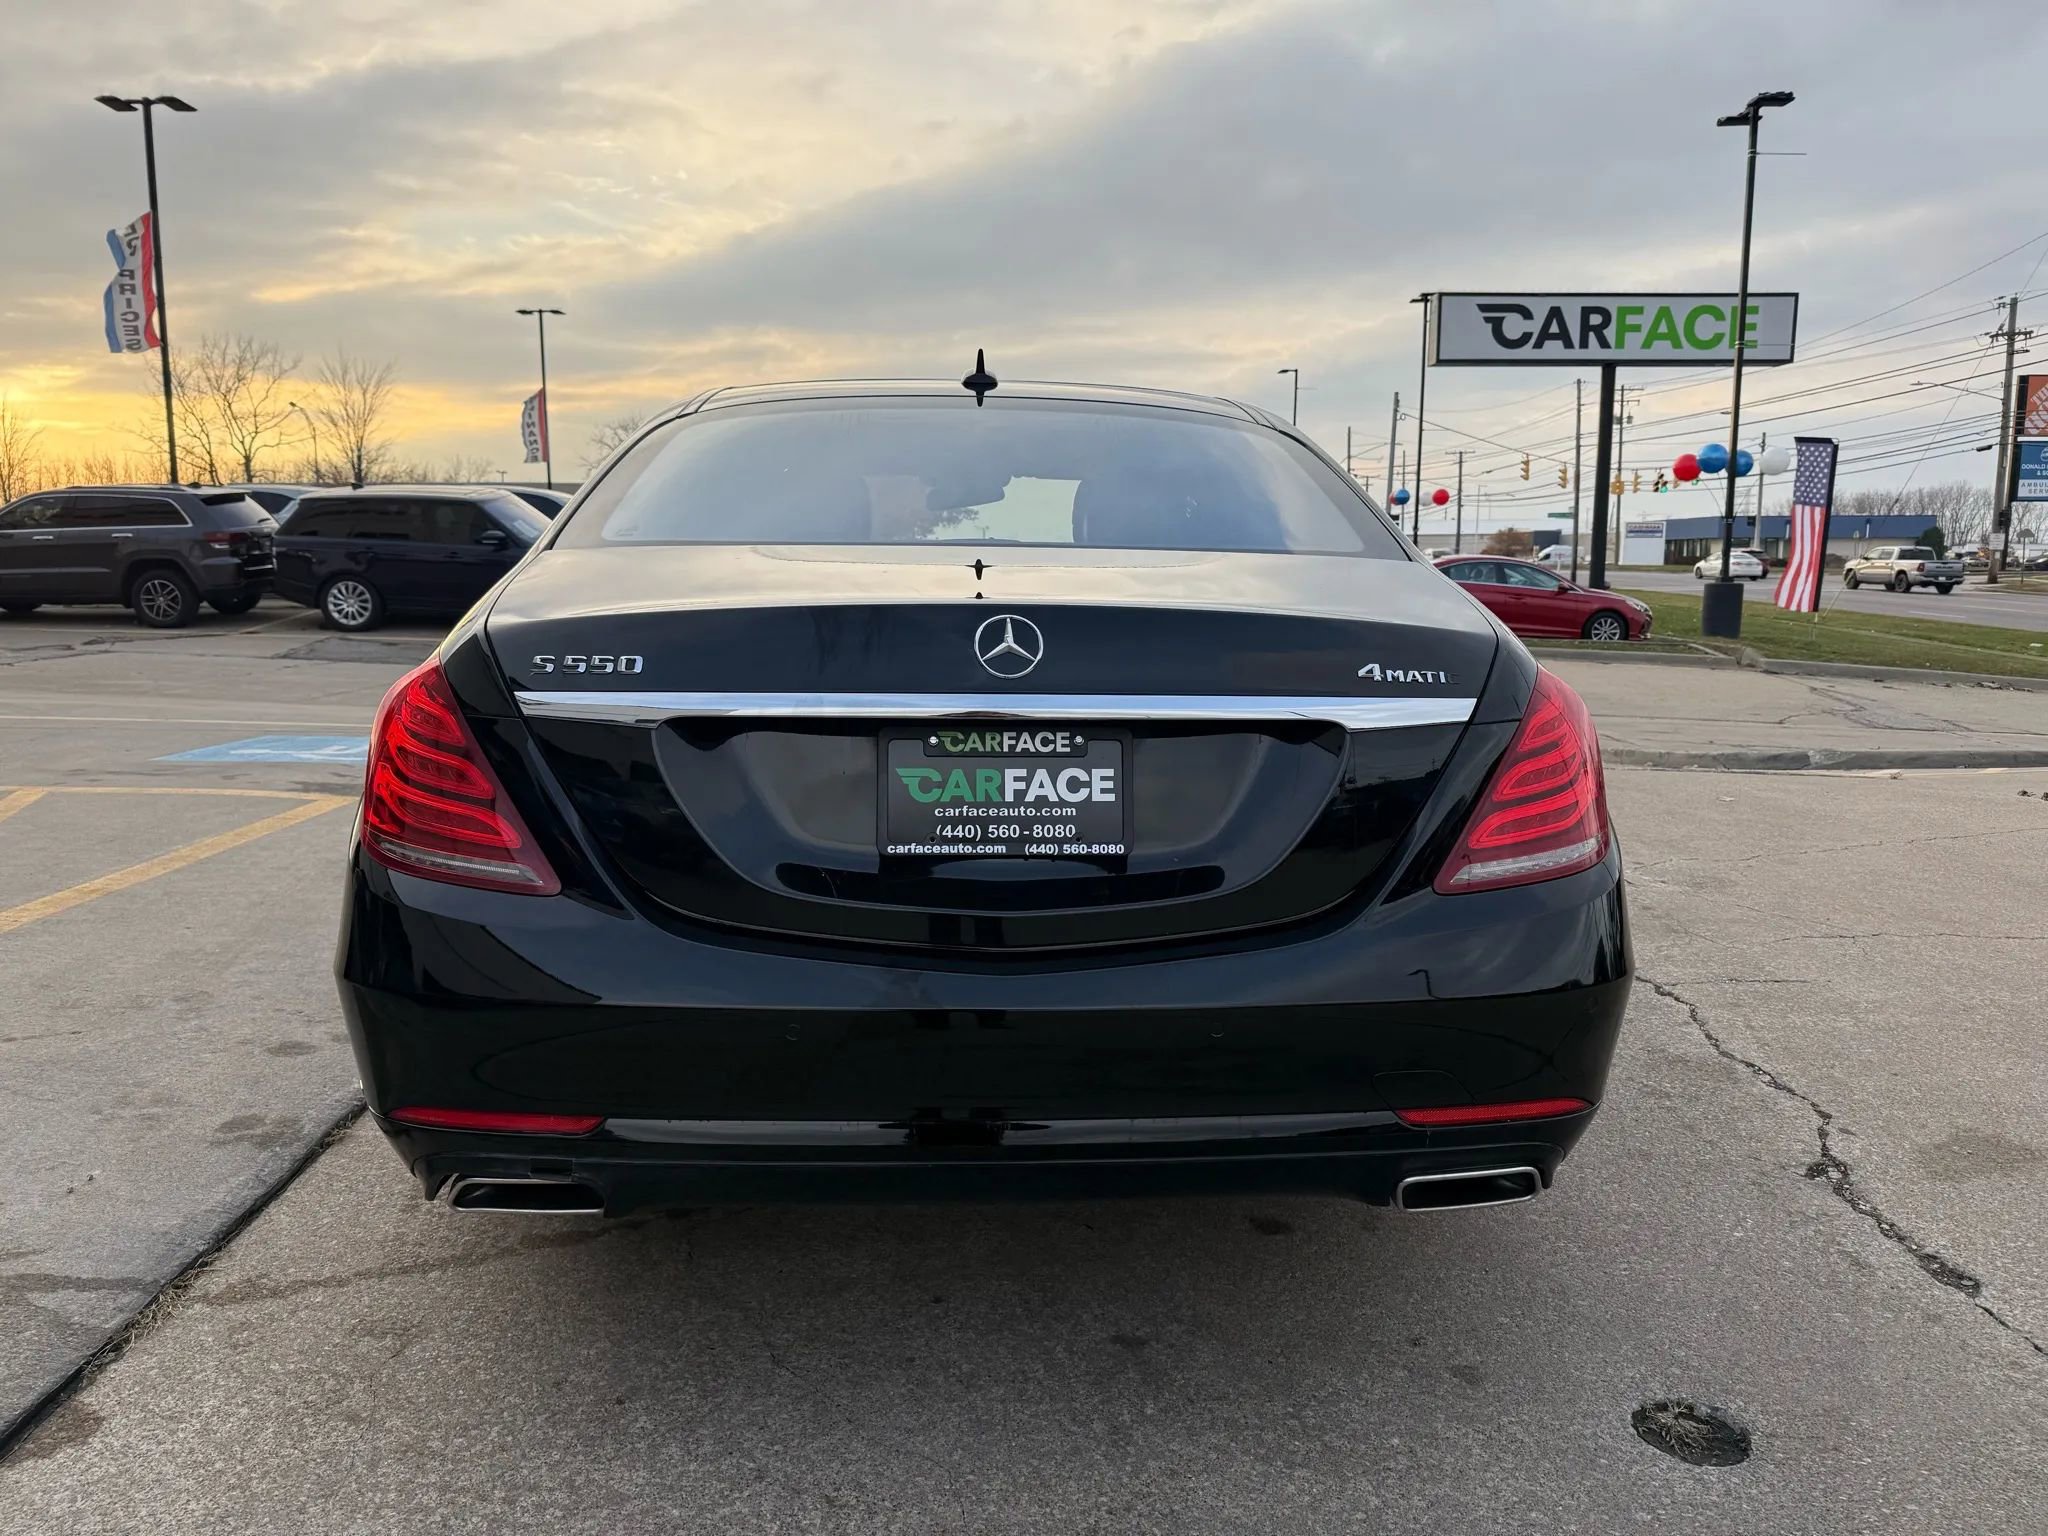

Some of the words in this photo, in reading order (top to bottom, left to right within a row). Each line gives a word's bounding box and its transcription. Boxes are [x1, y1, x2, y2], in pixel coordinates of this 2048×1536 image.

[1476, 303, 1760, 350] CARFACE
[530, 655, 556, 675] S
[561, 655, 643, 675] 550
[937, 731, 1071, 753] CARFACE
[895, 767, 1116, 803] CARFACE
[934, 805, 1077, 817] carfaceauto.com
[936, 824, 983, 842] (440)
[887, 843, 1006, 854] carfaceauto.com
[1024, 843, 1059, 856] (440)
[1062, 843, 1125, 855] 560-8080
